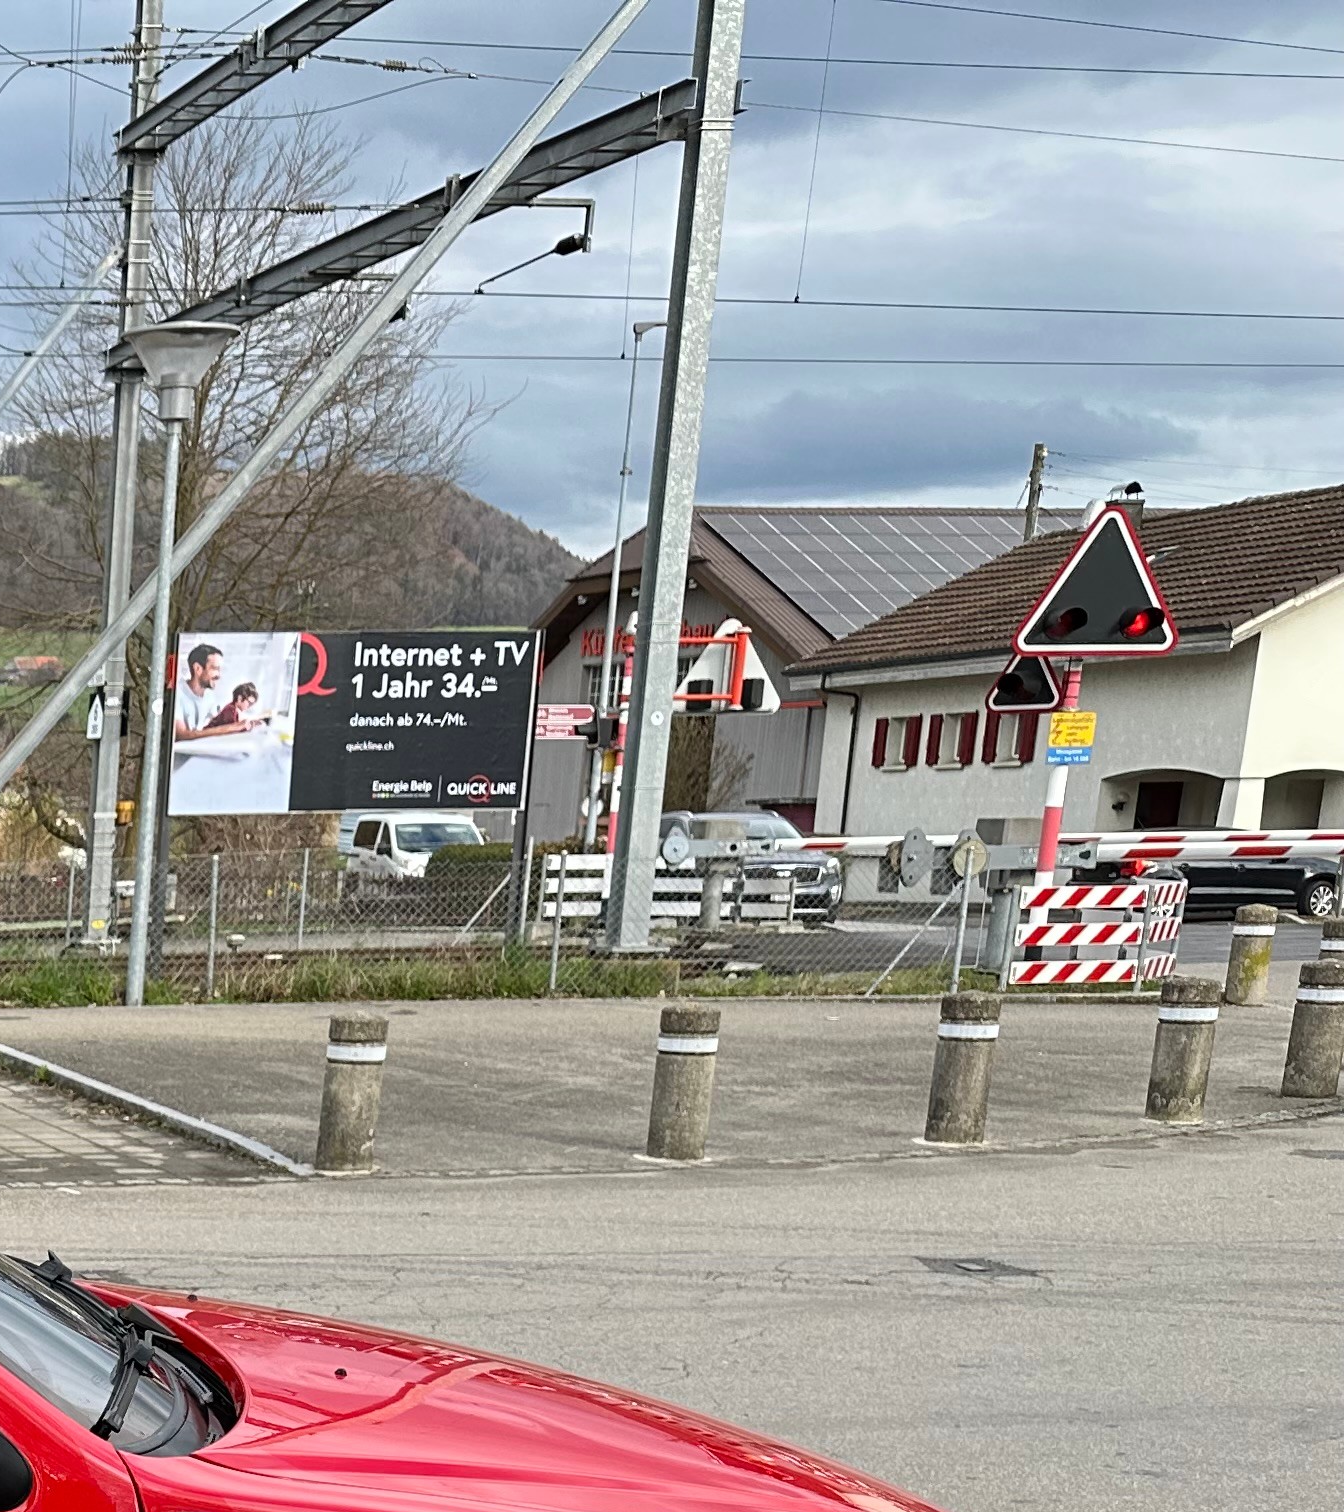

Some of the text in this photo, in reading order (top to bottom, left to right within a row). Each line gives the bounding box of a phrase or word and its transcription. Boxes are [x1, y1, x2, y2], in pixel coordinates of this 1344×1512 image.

[354, 640, 530, 667] Internet + TV
[351, 673, 364, 699] 1
[371, 671, 433, 699] Jahr
[349, 712, 394, 727] danach
[397, 712, 413, 727] ab
[346, 740, 395, 753] quickline.ch
[372, 780, 409, 793] Energie
